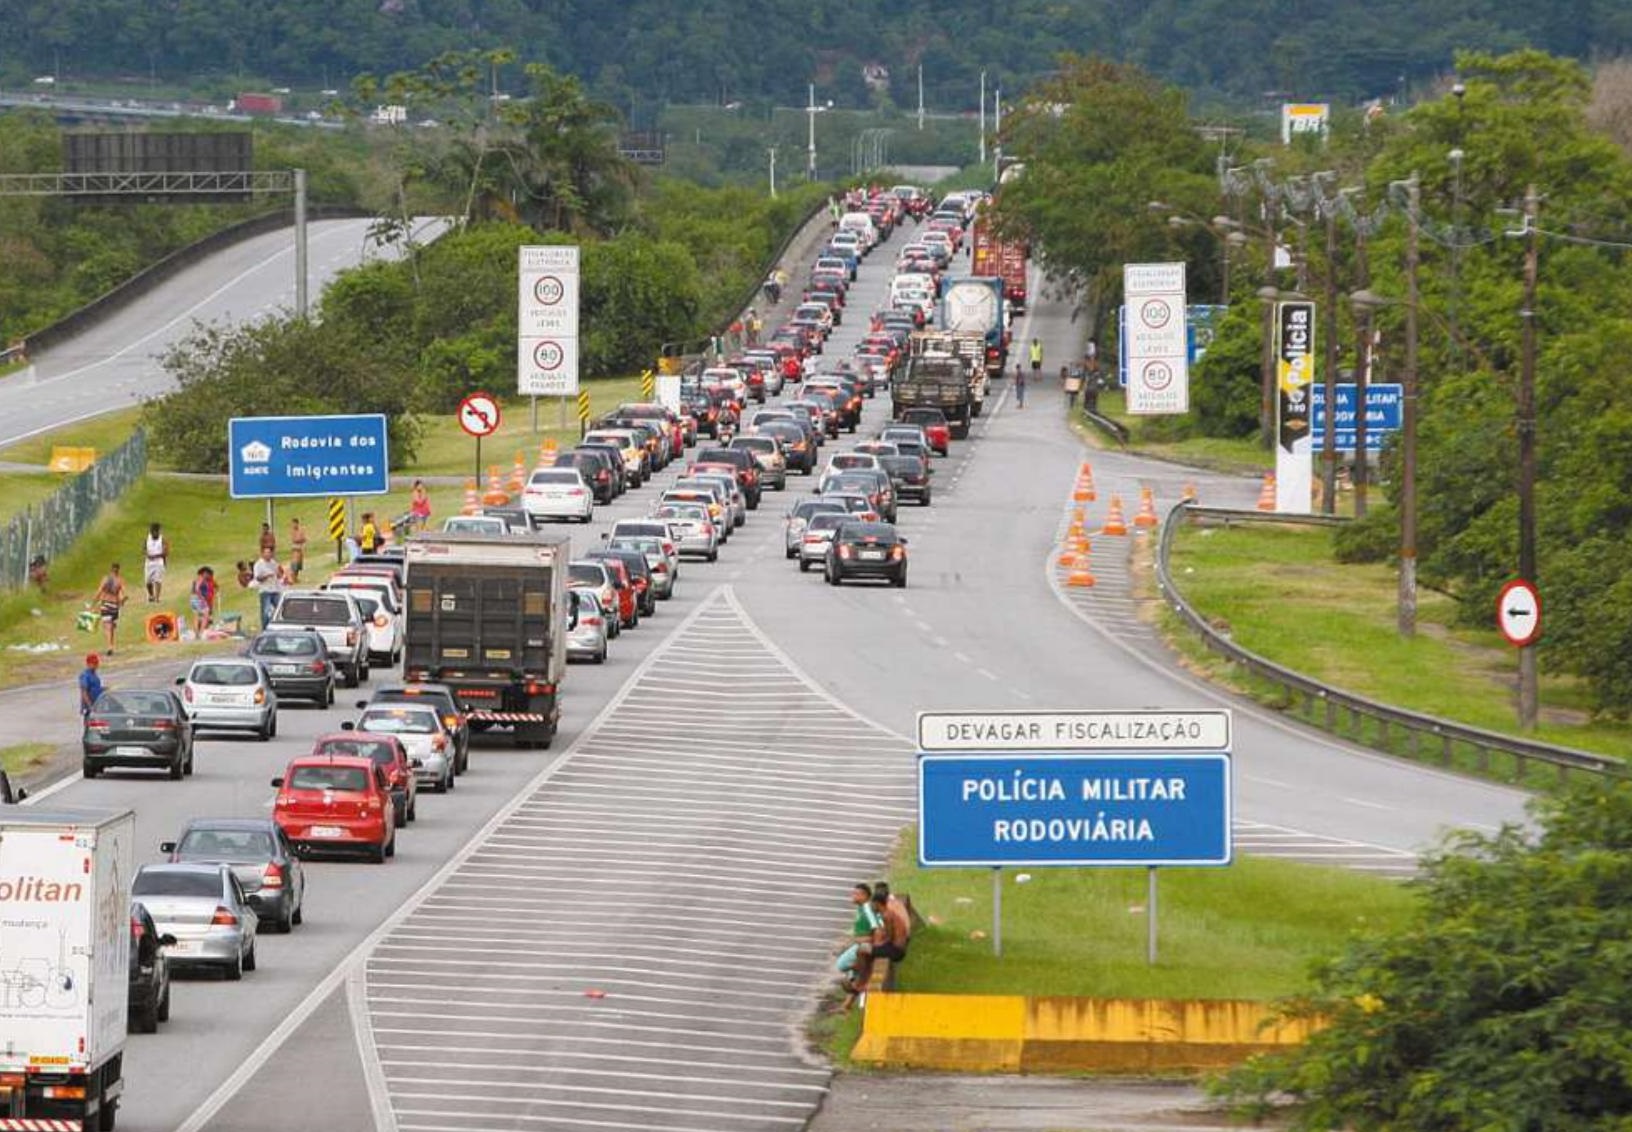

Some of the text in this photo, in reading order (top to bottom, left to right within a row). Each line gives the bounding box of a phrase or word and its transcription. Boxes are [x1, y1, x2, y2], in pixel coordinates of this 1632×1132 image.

[540, 284, 559, 295] 100
[1146, 307, 1167, 318] 100
[540, 350, 557, 361] 80
[1148, 369, 1166, 380] 80
[281, 434, 377, 449] Rodovia dos
[947, 718, 1202, 741] DEVAGAR FISCALIZAÇÃO
[962, 770, 1186, 801] POLÍCIA MILITAR
[993, 812, 1155, 842] RODOVIÁRIA
